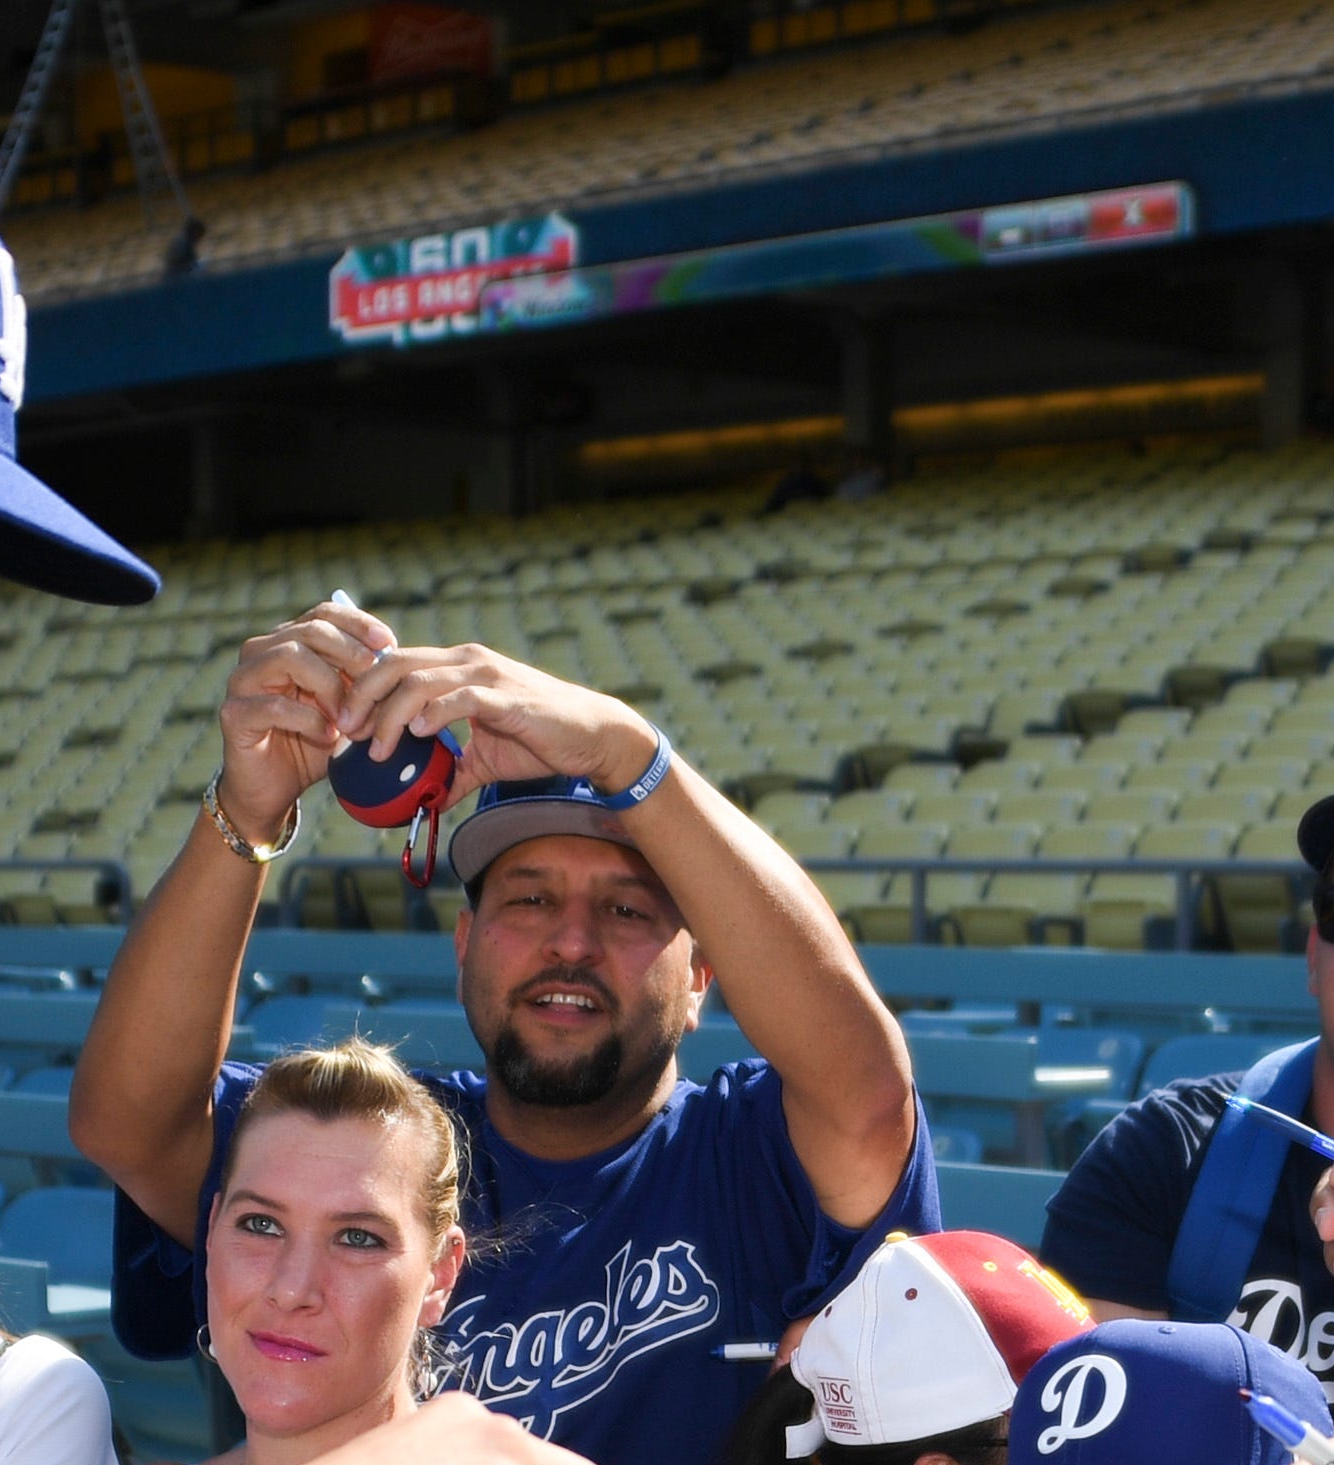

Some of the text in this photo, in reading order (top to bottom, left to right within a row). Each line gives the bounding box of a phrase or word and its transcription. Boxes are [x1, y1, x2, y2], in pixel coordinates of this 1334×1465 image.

[820, 1382, 853, 1404] USC
[1037, 1354, 1127, 1454] D
[826, 1407, 856, 1418] UNIVERSITY
